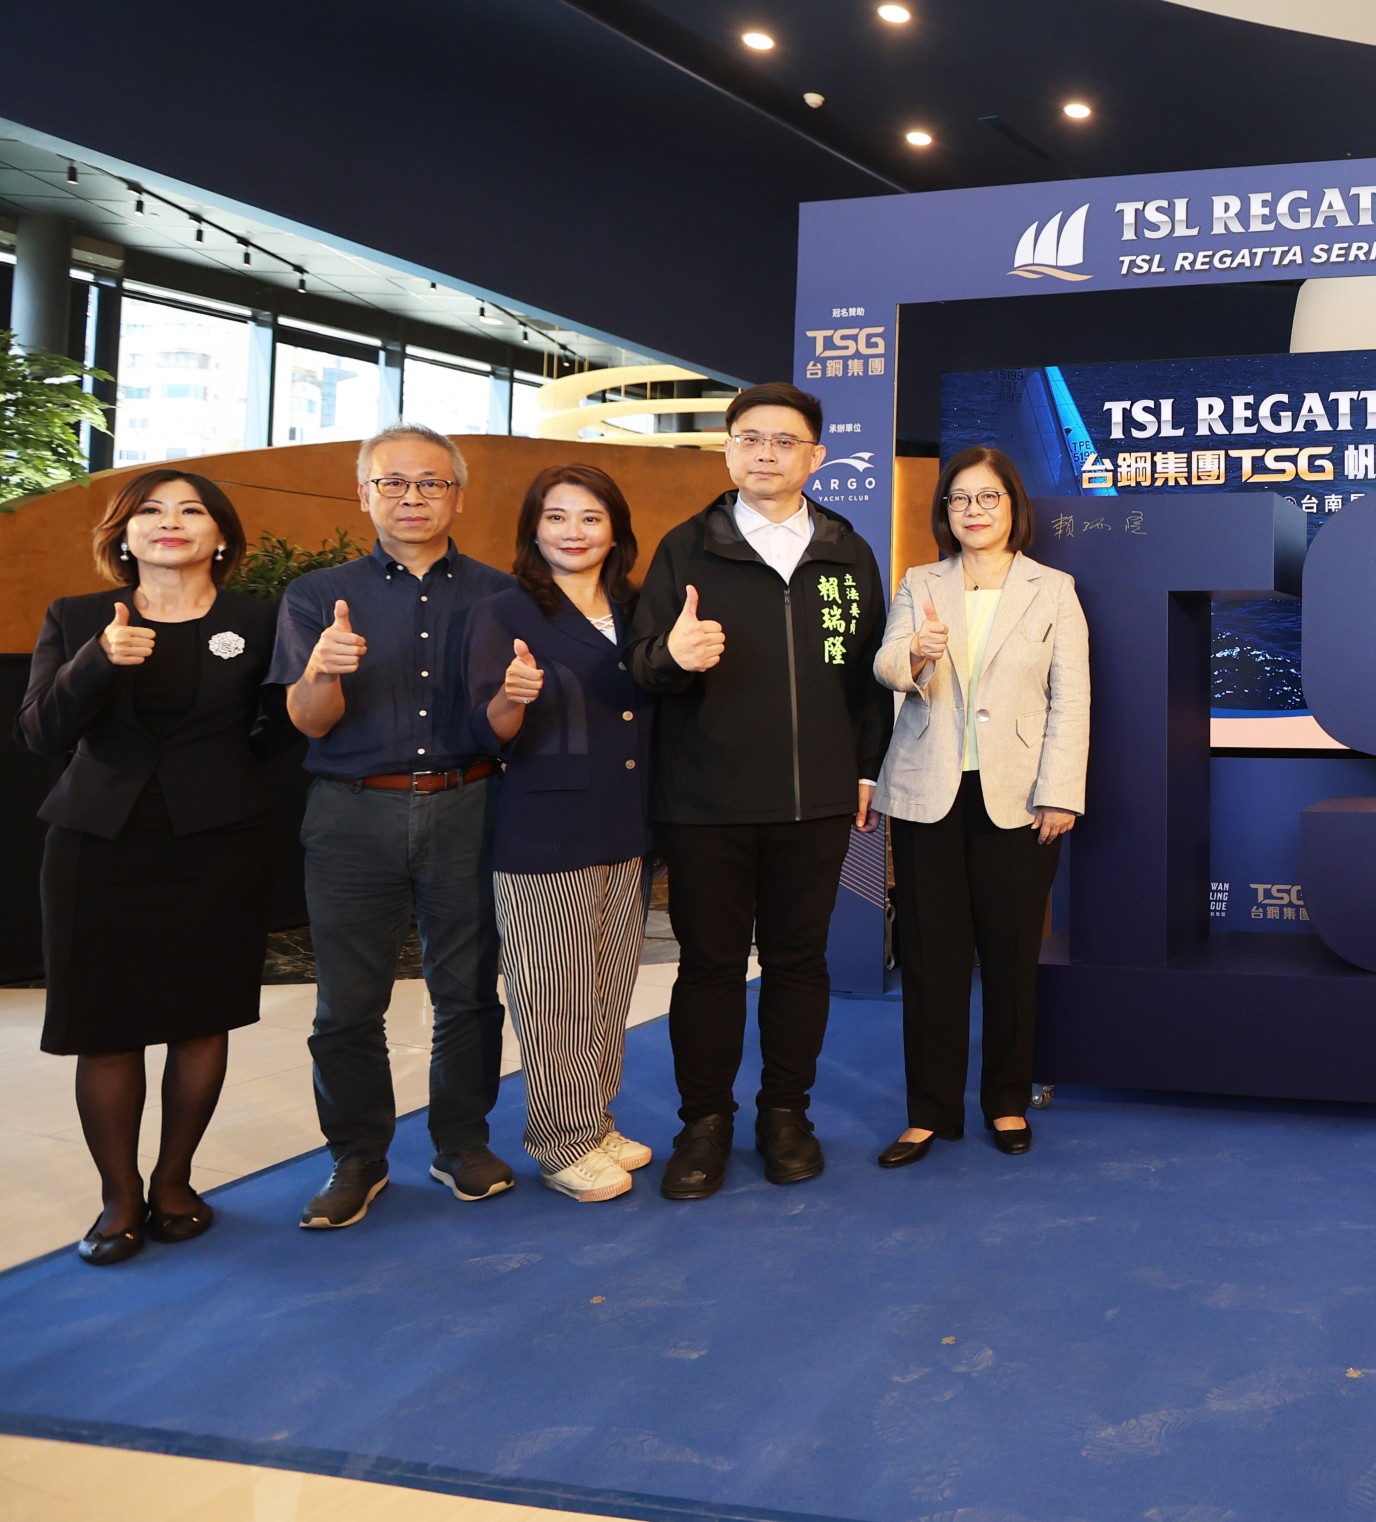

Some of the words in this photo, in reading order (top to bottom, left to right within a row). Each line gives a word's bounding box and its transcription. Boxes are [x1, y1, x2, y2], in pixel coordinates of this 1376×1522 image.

[1115, 198, 1200, 242] TSL
[1118, 254, 1166, 276] TSL
[1173, 245, 1303, 273] REGATTA
[805, 326, 886, 358] TSG
[805, 357, 885, 379] 台鋼集團
[828, 422, 862, 434] 承辦單位
[1102, 398, 1184, 439] TSL
[1080, 450, 1226, 489] 台鋼集團
[1228, 446, 1334, 483] TSG
[812, 477, 877, 491] ARGO
[848, 494, 869, 502] CLUB
[817, 575, 848, 665] 賴瑞隆
[843, 573, 861, 636] 立法委員
